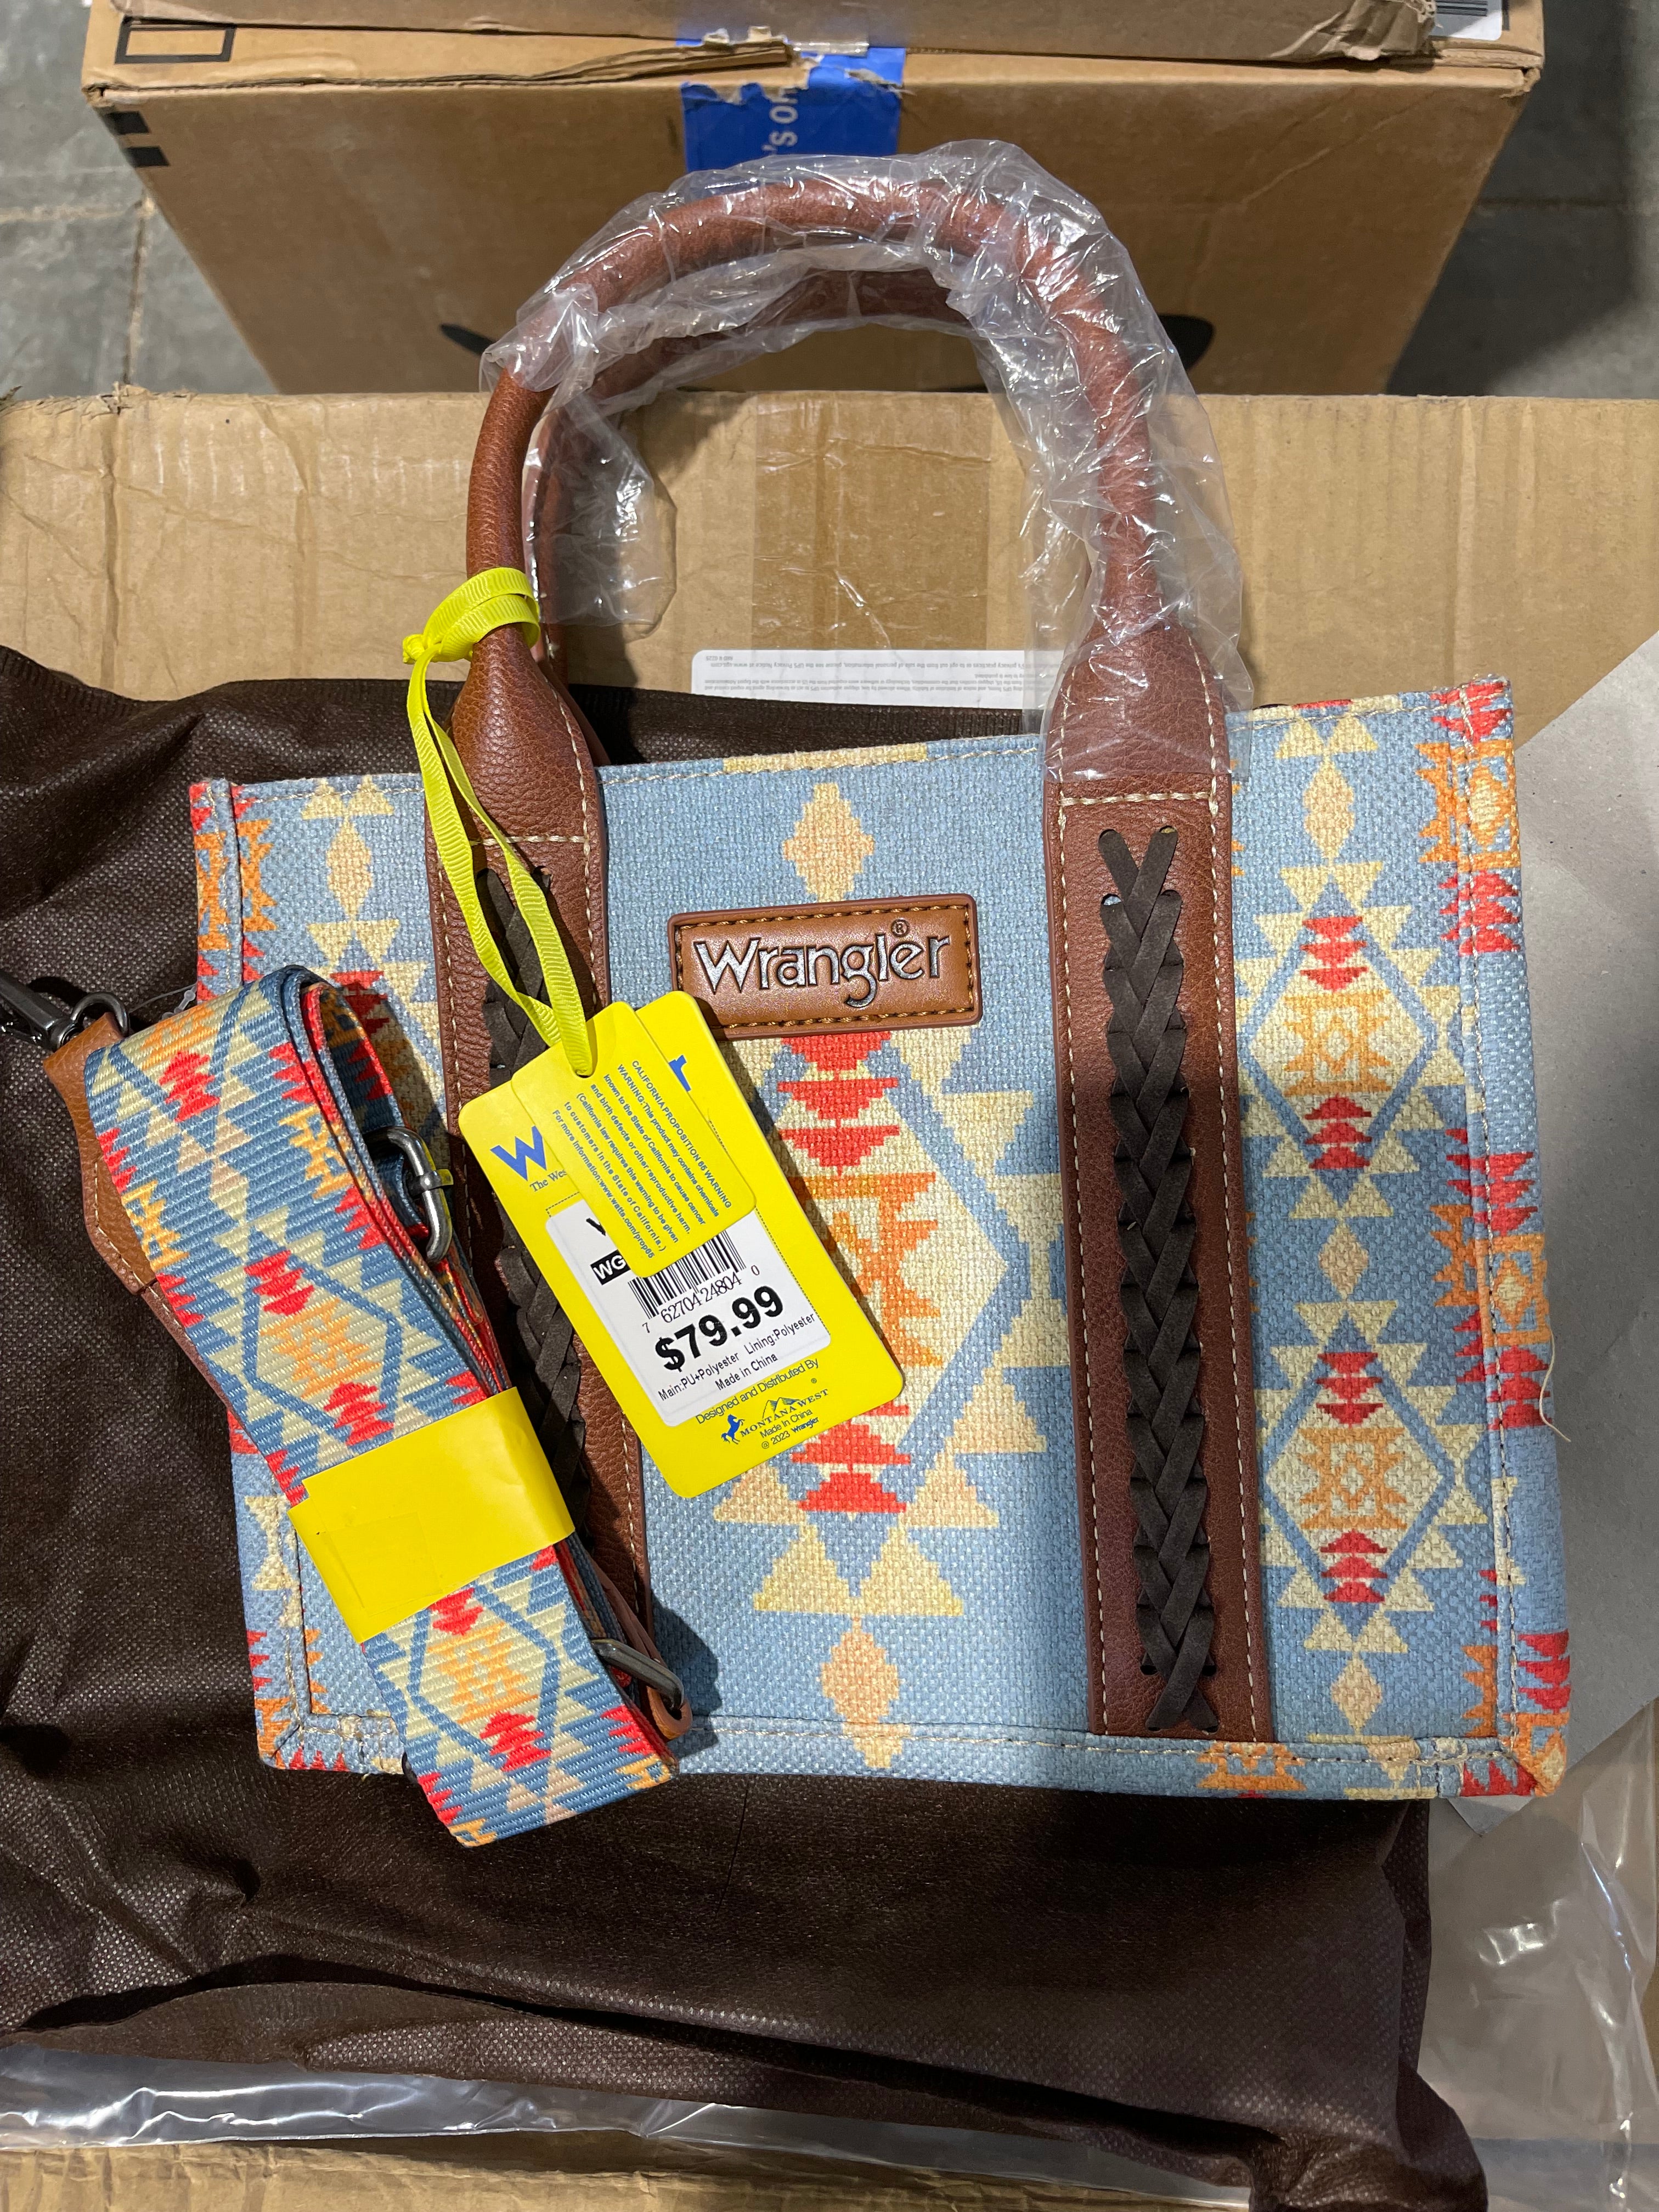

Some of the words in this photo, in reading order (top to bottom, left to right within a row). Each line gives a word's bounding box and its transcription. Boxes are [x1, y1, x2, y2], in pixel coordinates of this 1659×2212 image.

[692, 932, 950, 1008] Wrangler
[552, 1110, 563, 1122] For
[561, 1123, 574, 1141] more
[565, 1102, 572, 1110] to
[571, 1112, 599, 1152] customers
[603, 1161, 613, 1175] the
[612, 1175, 628, 1196] State
[591, 1085, 603, 1098] and
[600, 1097, 612, 1115] birth
[611, 1115, 630, 1141] defects
[634, 1150, 649, 1168] other
[646, 1169, 678, 1213] reproductive
[676, 1212, 690, 1234] harm.
[603, 1074, 620, 1097] known
[624, 1104, 632, 1116] the
[631, 1115, 644, 1134] State
[648, 1142, 670, 1175] California
[674, 1182, 689, 1202] cause
[688, 1203, 706, 1224] cancer
[633, 1061, 665, 1109] CALIFORNIA
[662, 1107, 701, 1161] PROPOSITION
[698, 1161, 707, 1171] 65
[704, 1170, 731, 1207] WARNING
[529, 1180, 548, 1192] The
[577, 1093, 602, 1128] (California
[600, 1127, 611, 1139] law
[608, 1141, 628, 1168] requires
[627, 1167, 636, 1181] this
[635, 1181, 655, 1207] warning
[658, 1214, 665, 1224] be
[663, 1224, 678, 1243] given
[650, 1119, 671, 1144] product
[668, 1143, 680, 1157] may
[678, 1158, 697, 1184] contains
[696, 1185, 719, 1217] chemicals
[642, 1322, 650, 1333] 7
[661, 1291, 702, 1323] 62704
[700, 1270, 742, 1302] 24804
[751, 1265, 759, 1276] 0
[655, 1286, 783, 1372] $79.99
[658, 1353, 739, 1401] Main:PU+Polyester
[744, 1314, 815, 1355] Lining:Polyester
[695, 1396, 740, 1424] Designed
[740, 1386, 758, 1402] and
[757, 1363, 805, 1392] Distributed
[804, 1359, 818, 1369] By
[715, 1373, 740, 1390] Made
[740, 1368, 751, 1377] in
[751, 1354, 778, 1370] China
[740, 1403, 797, 1437] MONTANA
[797, 1389, 828, 1407] WEST
[760, 1425, 782, 1438] Made
[791, 1409, 812, 1423] China
[771, 1431, 790, 1444] 2023
